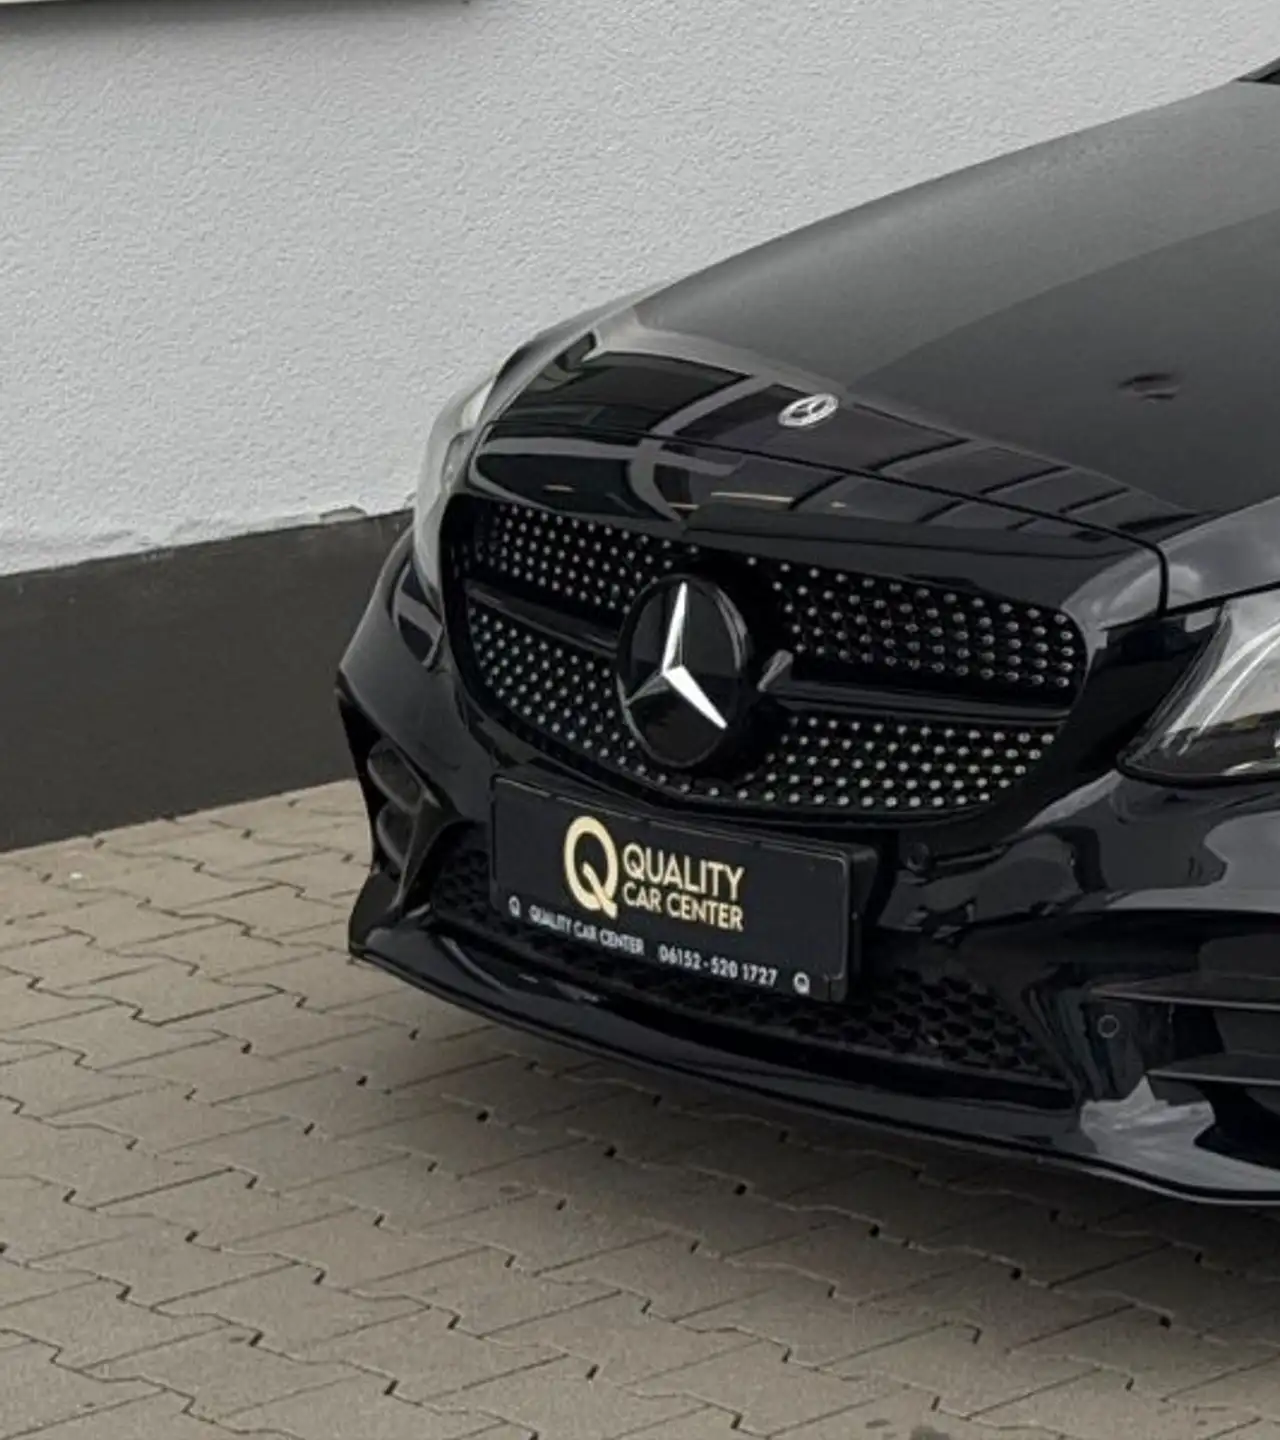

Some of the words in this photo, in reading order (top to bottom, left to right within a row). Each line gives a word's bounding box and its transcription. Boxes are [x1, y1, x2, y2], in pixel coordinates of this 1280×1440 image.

[564, 816, 619, 919] Q
[622, 842, 745, 902] QUALITY
[622, 880, 663, 914] CAR
[665, 891, 745, 932] CENTER
[528, 904, 572, 934] QUALITY
[573, 920, 598, 942] CAR
[600, 928, 646, 956] CENTER
[741, 962, 778, 988] 1727
